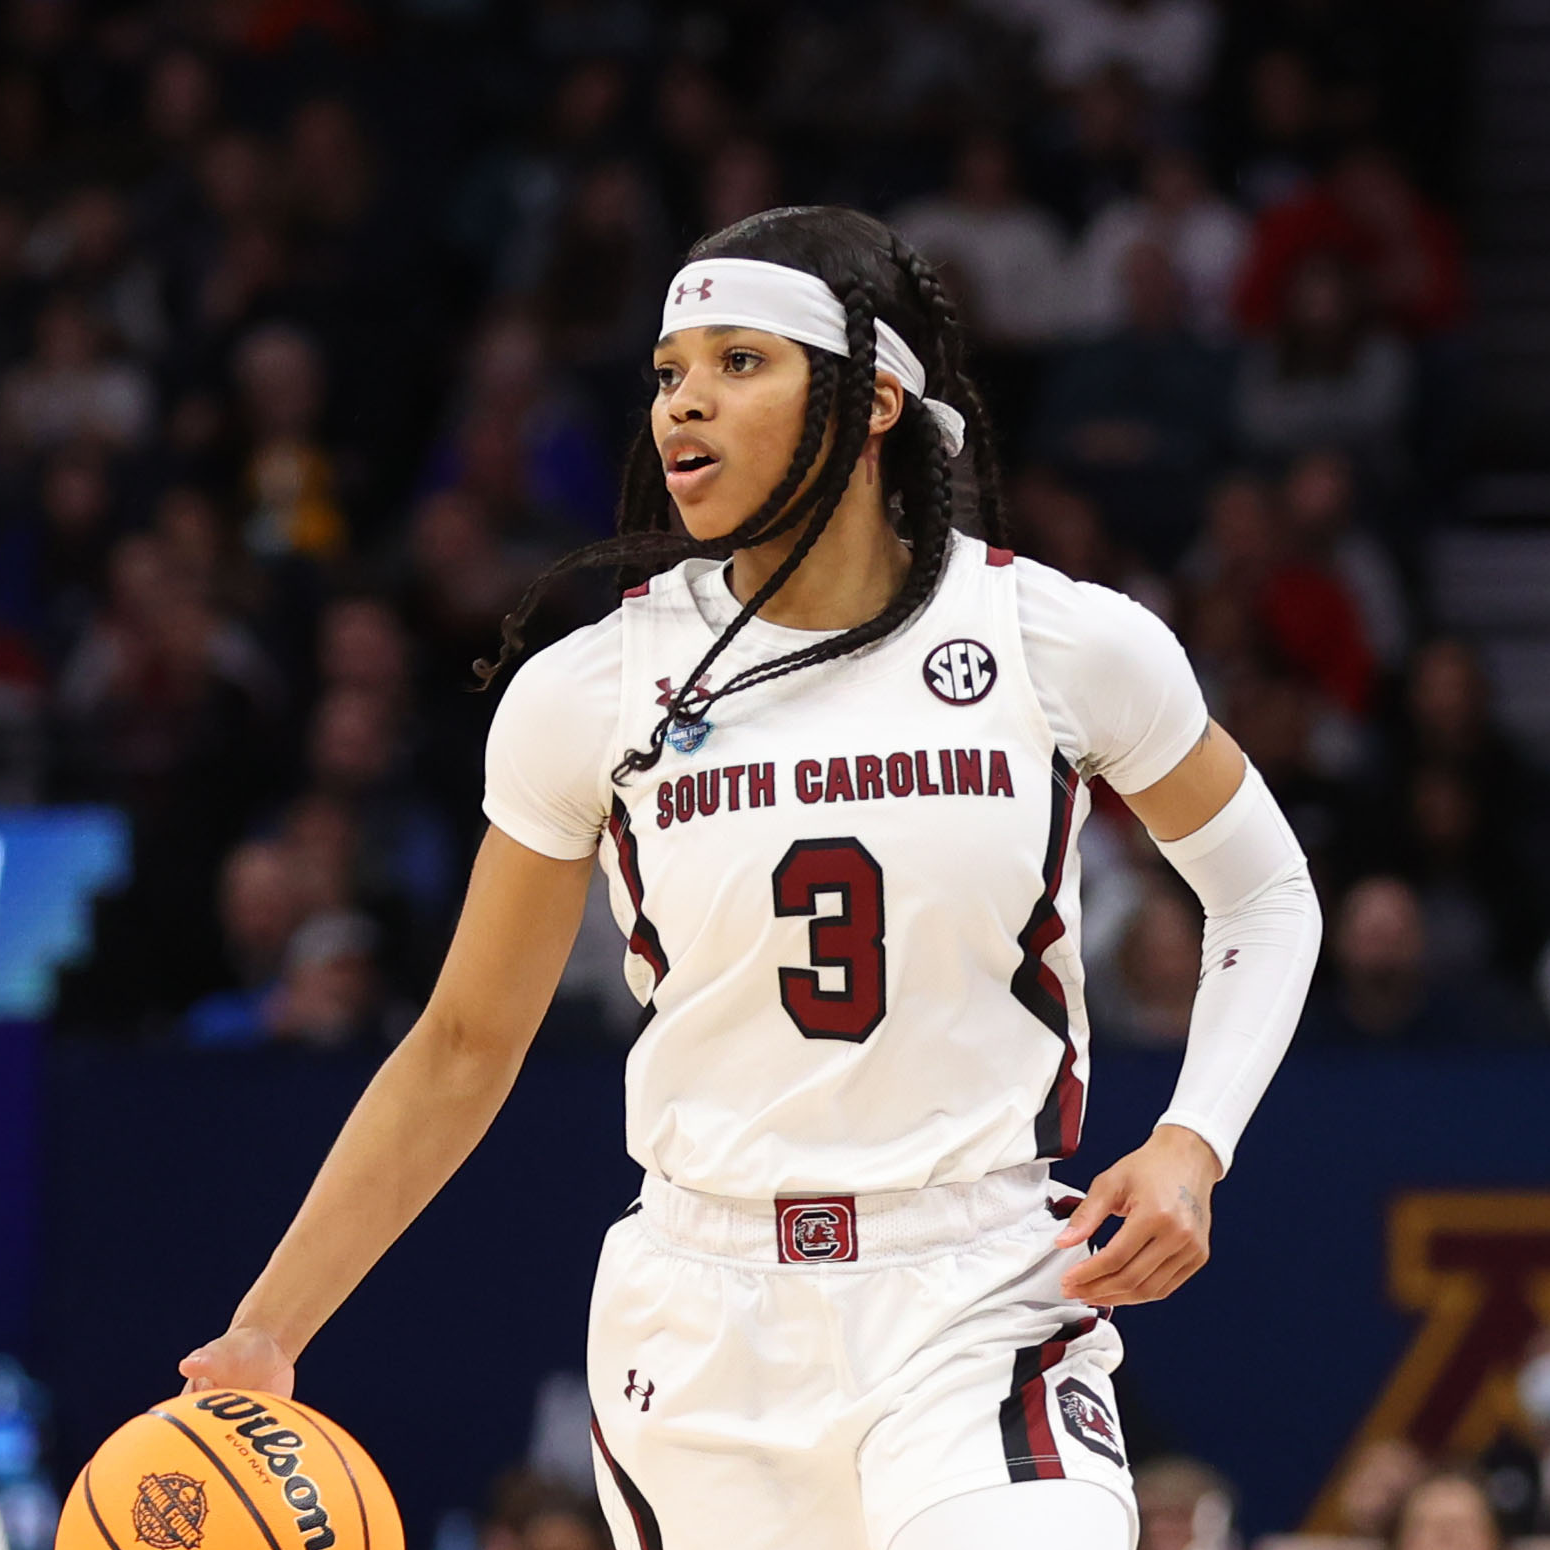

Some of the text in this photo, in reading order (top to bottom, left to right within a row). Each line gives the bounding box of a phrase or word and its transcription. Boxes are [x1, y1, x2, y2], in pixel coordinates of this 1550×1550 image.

[926, 640, 995, 703] SEC
[656, 748, 1016, 831] SOUTH CAROLINA
[771, 835, 887, 1044] 3
[224, 1433, 273, 1486] EVO NXT
[140, 1477, 173, 1515] FINAL
[164, 1507, 199, 1547] FOUR
